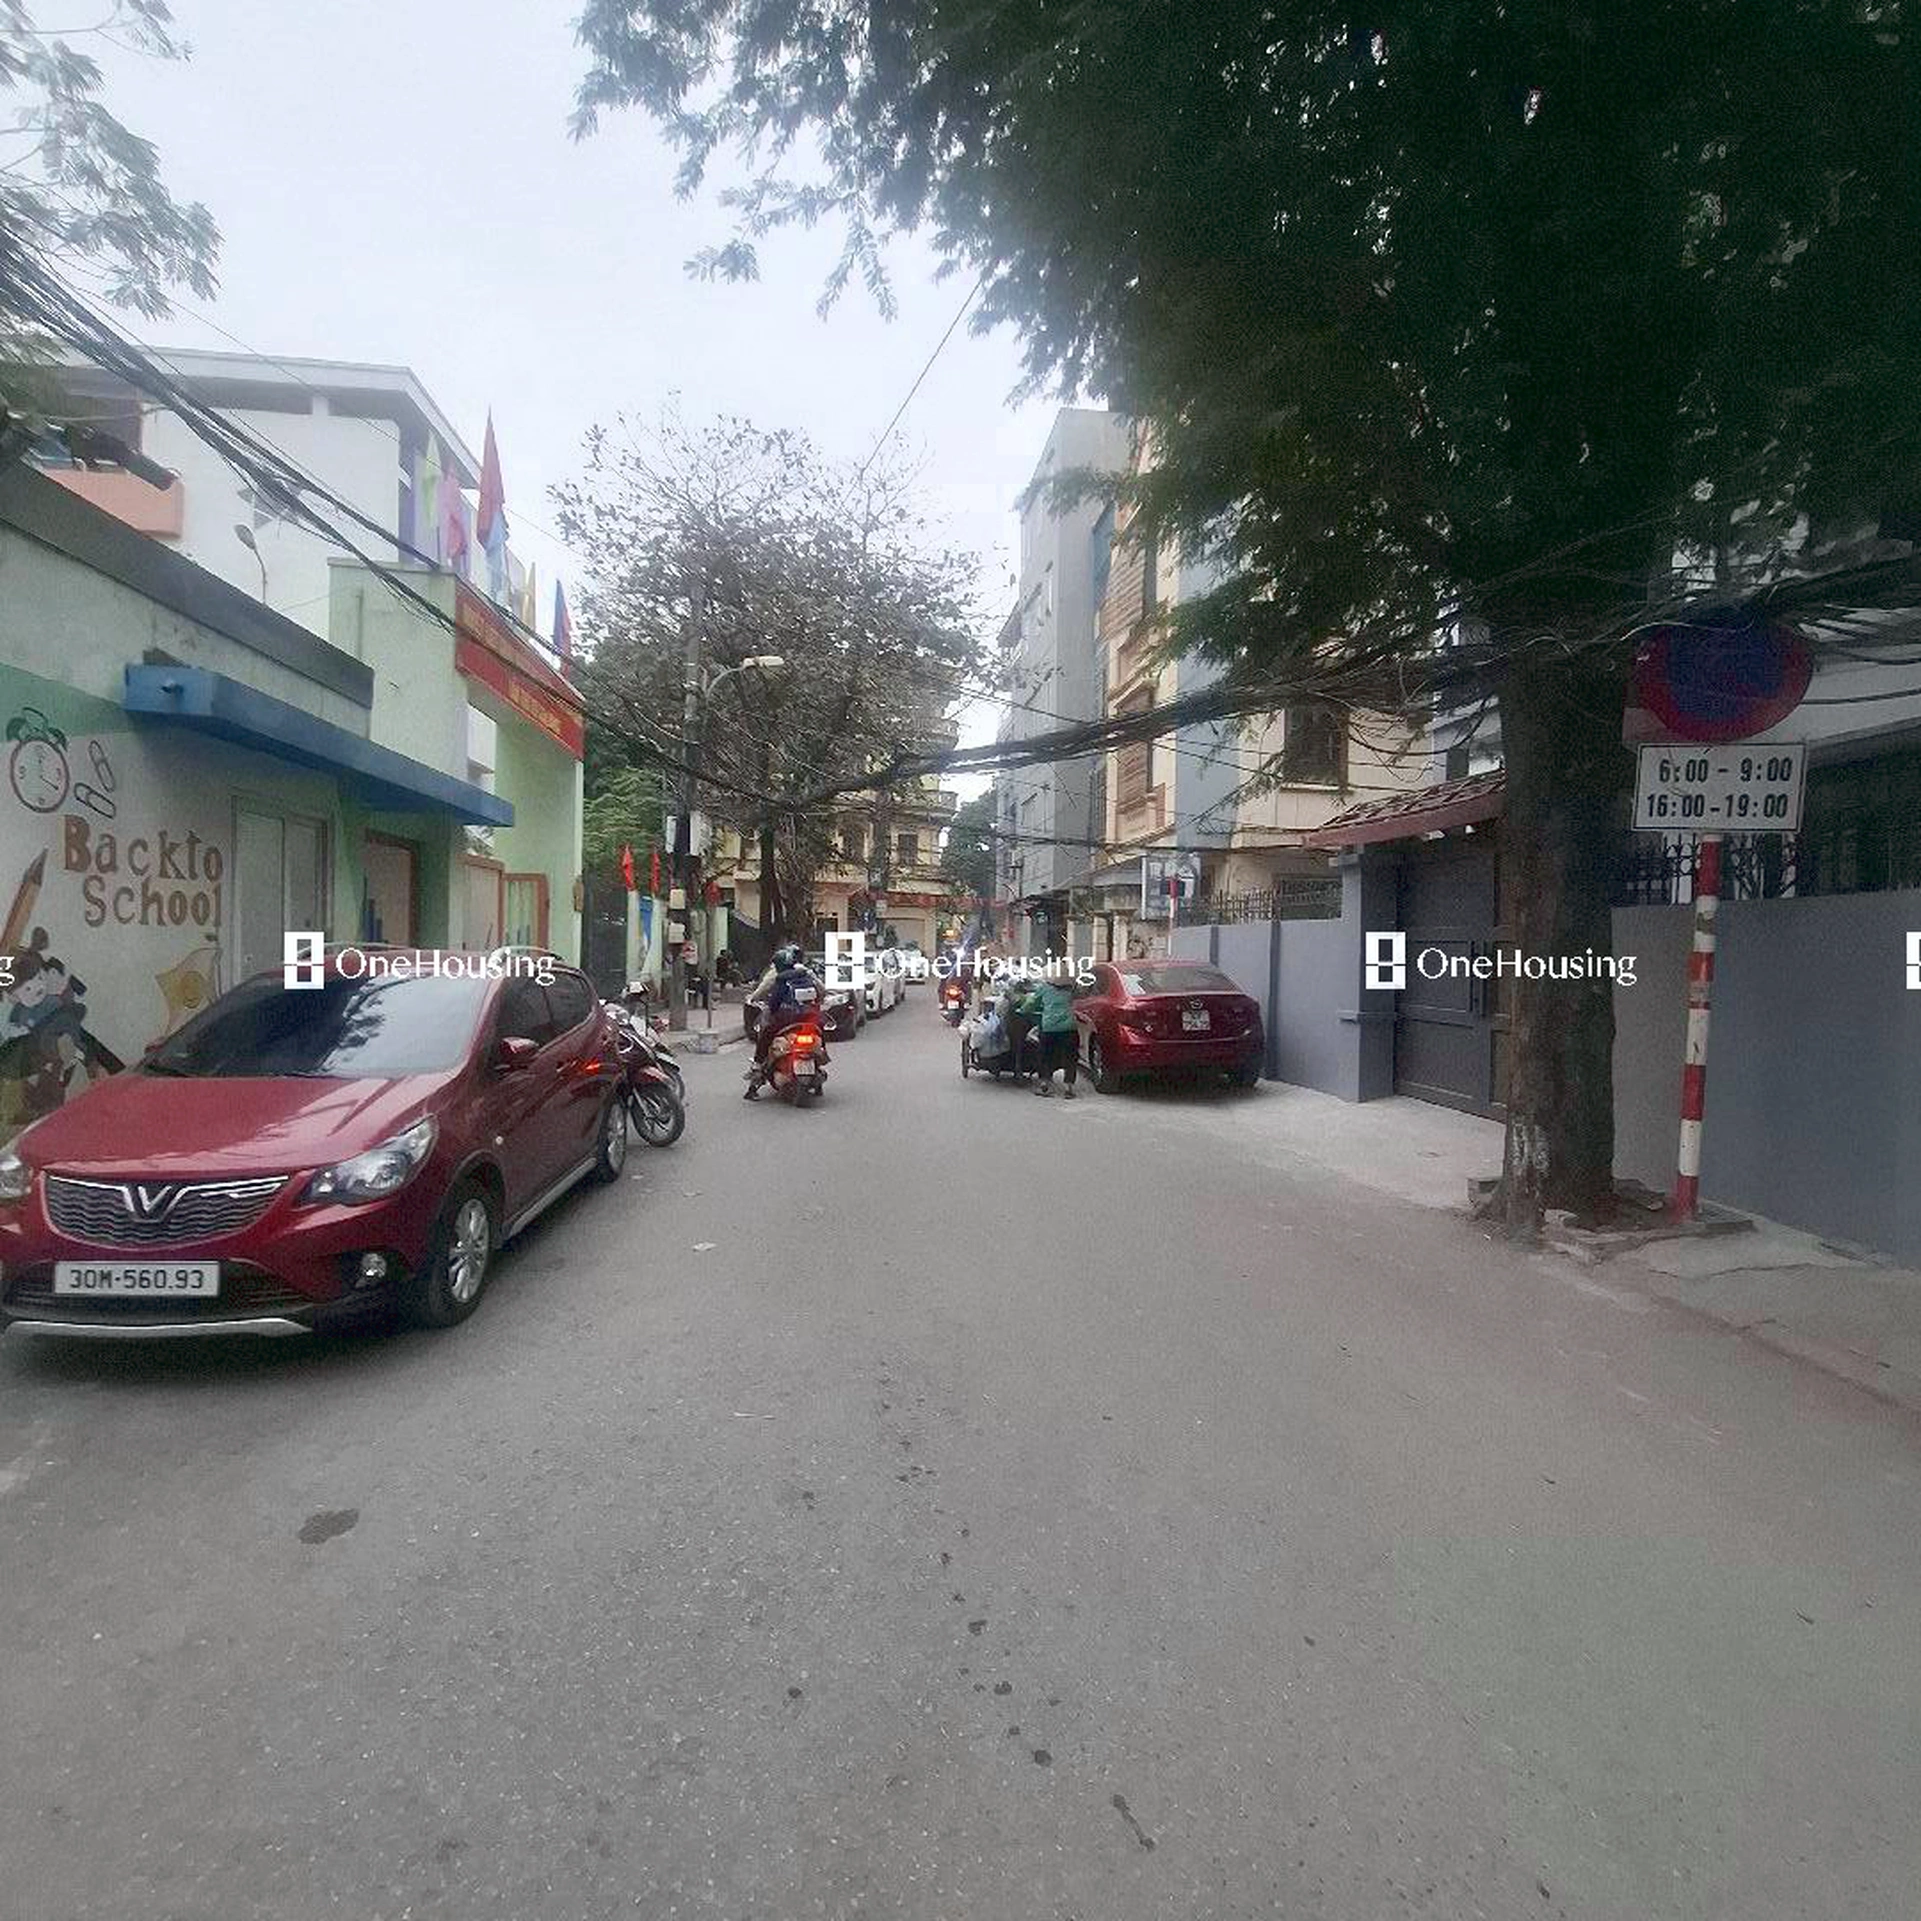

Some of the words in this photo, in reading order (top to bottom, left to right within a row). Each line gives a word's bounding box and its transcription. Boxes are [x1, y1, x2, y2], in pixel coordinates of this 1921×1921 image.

[1659, 758, 1708, 783] 6:00
[1740, 757, 1793, 782] 9:00
[83, 874, 222, 927] School
